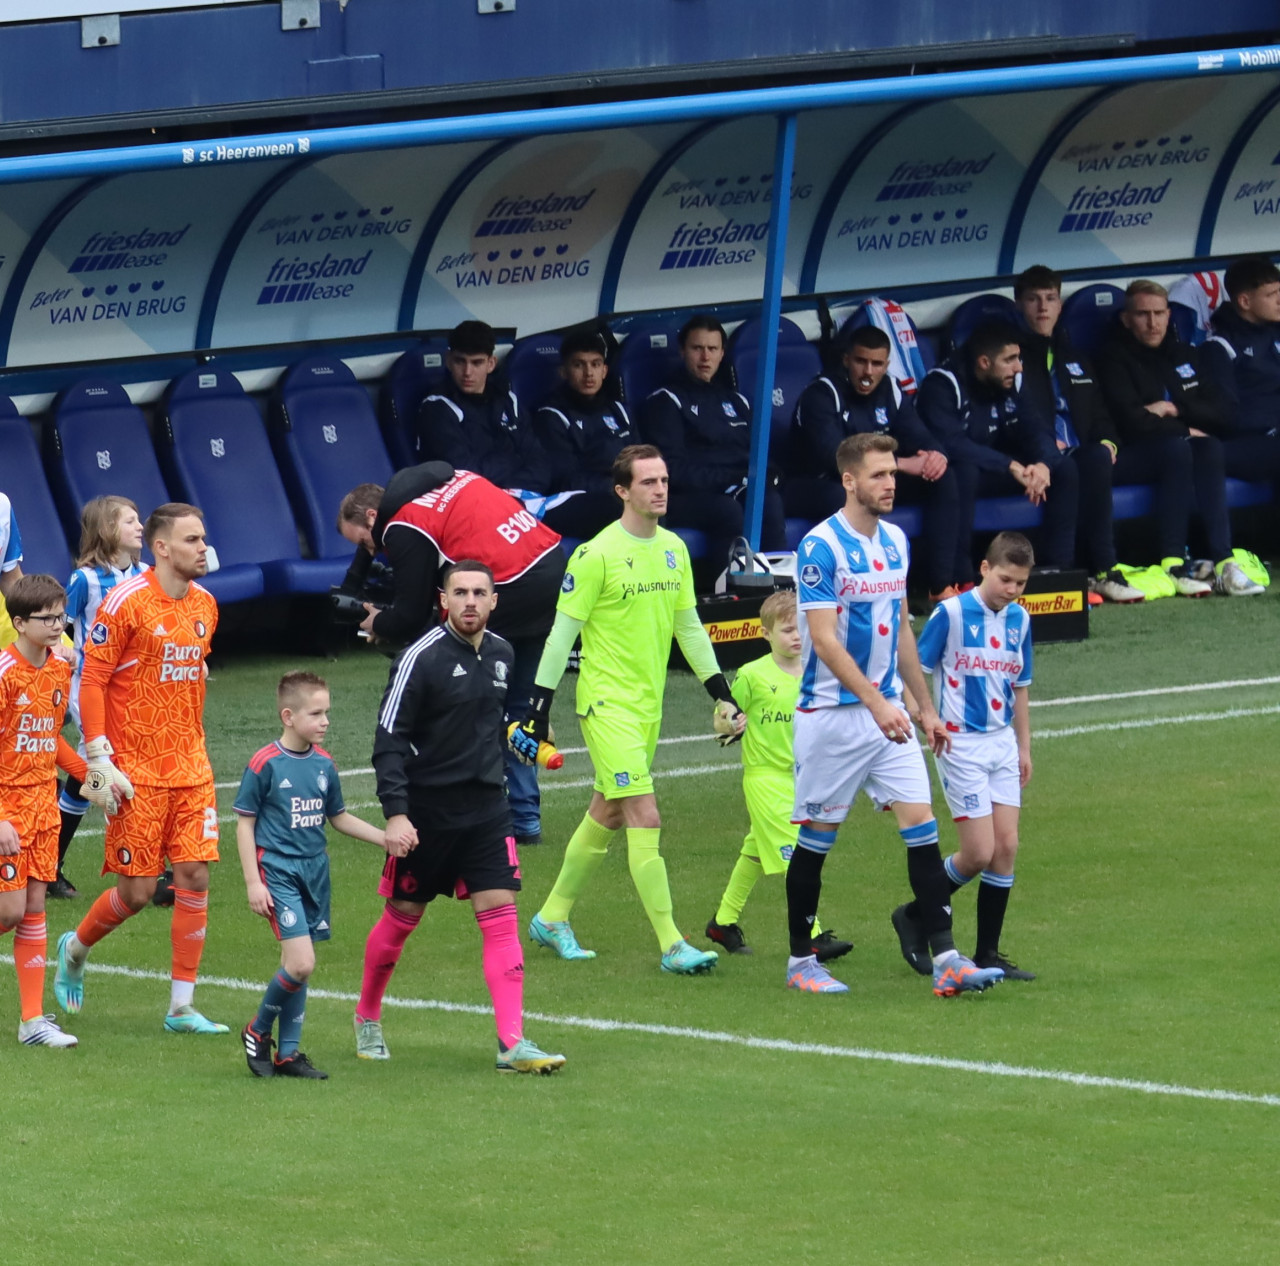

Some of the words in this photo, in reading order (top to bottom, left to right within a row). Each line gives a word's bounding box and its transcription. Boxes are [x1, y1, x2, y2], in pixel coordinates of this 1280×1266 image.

[199, 150, 214, 162] sc
[216, 142, 294, 160] Heerenveen
[1078, 156, 1115, 173] VAN
[1117, 153, 1159, 170] DEN
[1160, 148, 1210, 165] BRUG
[888, 152, 996, 183] friesland
[922, 180, 973, 197] lease
[1067, 178, 1172, 211] friesland
[488, 188, 597, 218] friesland
[680, 194, 716, 210] VAN
[720, 189, 760, 206] DEN
[522, 217, 572, 233] lease
[838, 216, 880, 238] Beter
[1105, 210, 1152, 229] lease
[80, 223, 192, 254] friesland
[275, 229, 313, 246] VAN
[317, 224, 358, 242] DEN
[360, 219, 412, 237] BRUG
[669, 218, 770, 248] friesland
[857, 233, 893, 252] VAN
[898, 229, 936, 248] DEN
[940, 224, 988, 244] BRUG
[118, 252, 168, 269] lease
[266, 249, 373, 283] friesland
[436, 252, 478, 273] Beter
[707, 248, 756, 266] lease
[455, 269, 492, 288] VAN
[497, 265, 536, 285] DEN
[541, 260, 590, 280] BRUG
[30, 288, 73, 310] Beter
[305, 282, 354, 300] lease
[50, 305, 88, 325] VAN
[92, 301, 132, 321] DEN
[136, 295, 187, 316] BRUG
[1016, 594, 1078, 614] PowerBar
[709, 622, 760, 642] PowerBar
[163, 642, 201, 662] Euro
[17, 713, 55, 732] Euro
[14, 733, 56, 753] Parcs
[290, 797, 323, 813] Euro
[203, 807, 220, 838] 2
